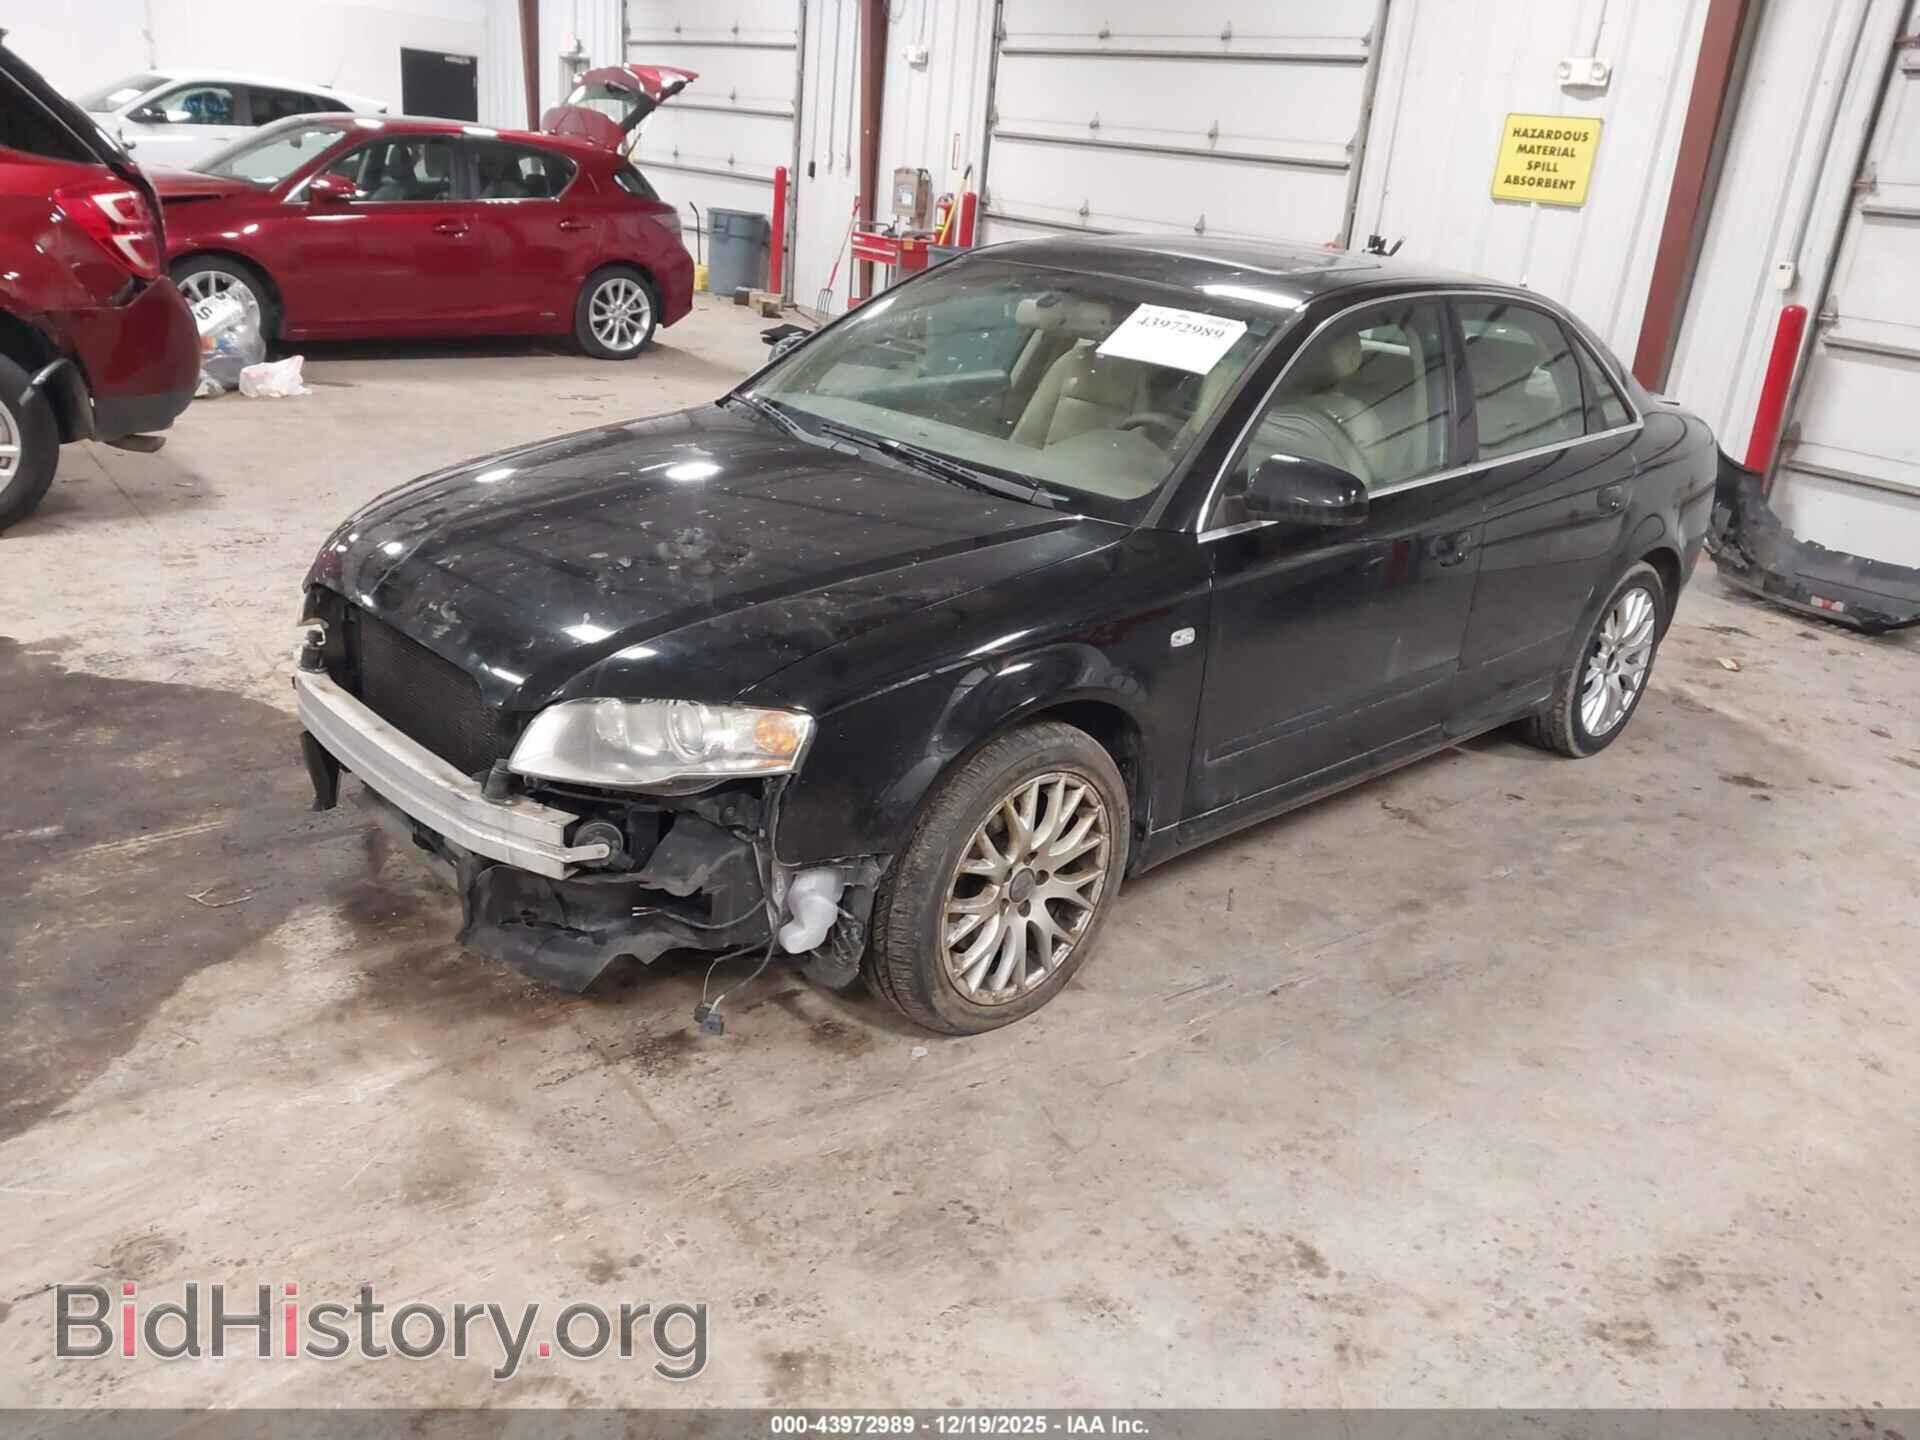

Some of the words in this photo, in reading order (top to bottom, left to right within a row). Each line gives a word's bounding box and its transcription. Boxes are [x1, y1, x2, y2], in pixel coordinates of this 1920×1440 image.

[1513, 127, 1589, 142] HAZARDOUS
[1517, 144, 1576, 158] MATERIAL
[1526, 160, 1559, 173] SPILL
[1504, 174, 1576, 190] ABSORBENT
[1138, 316, 1226, 338] 43972989
